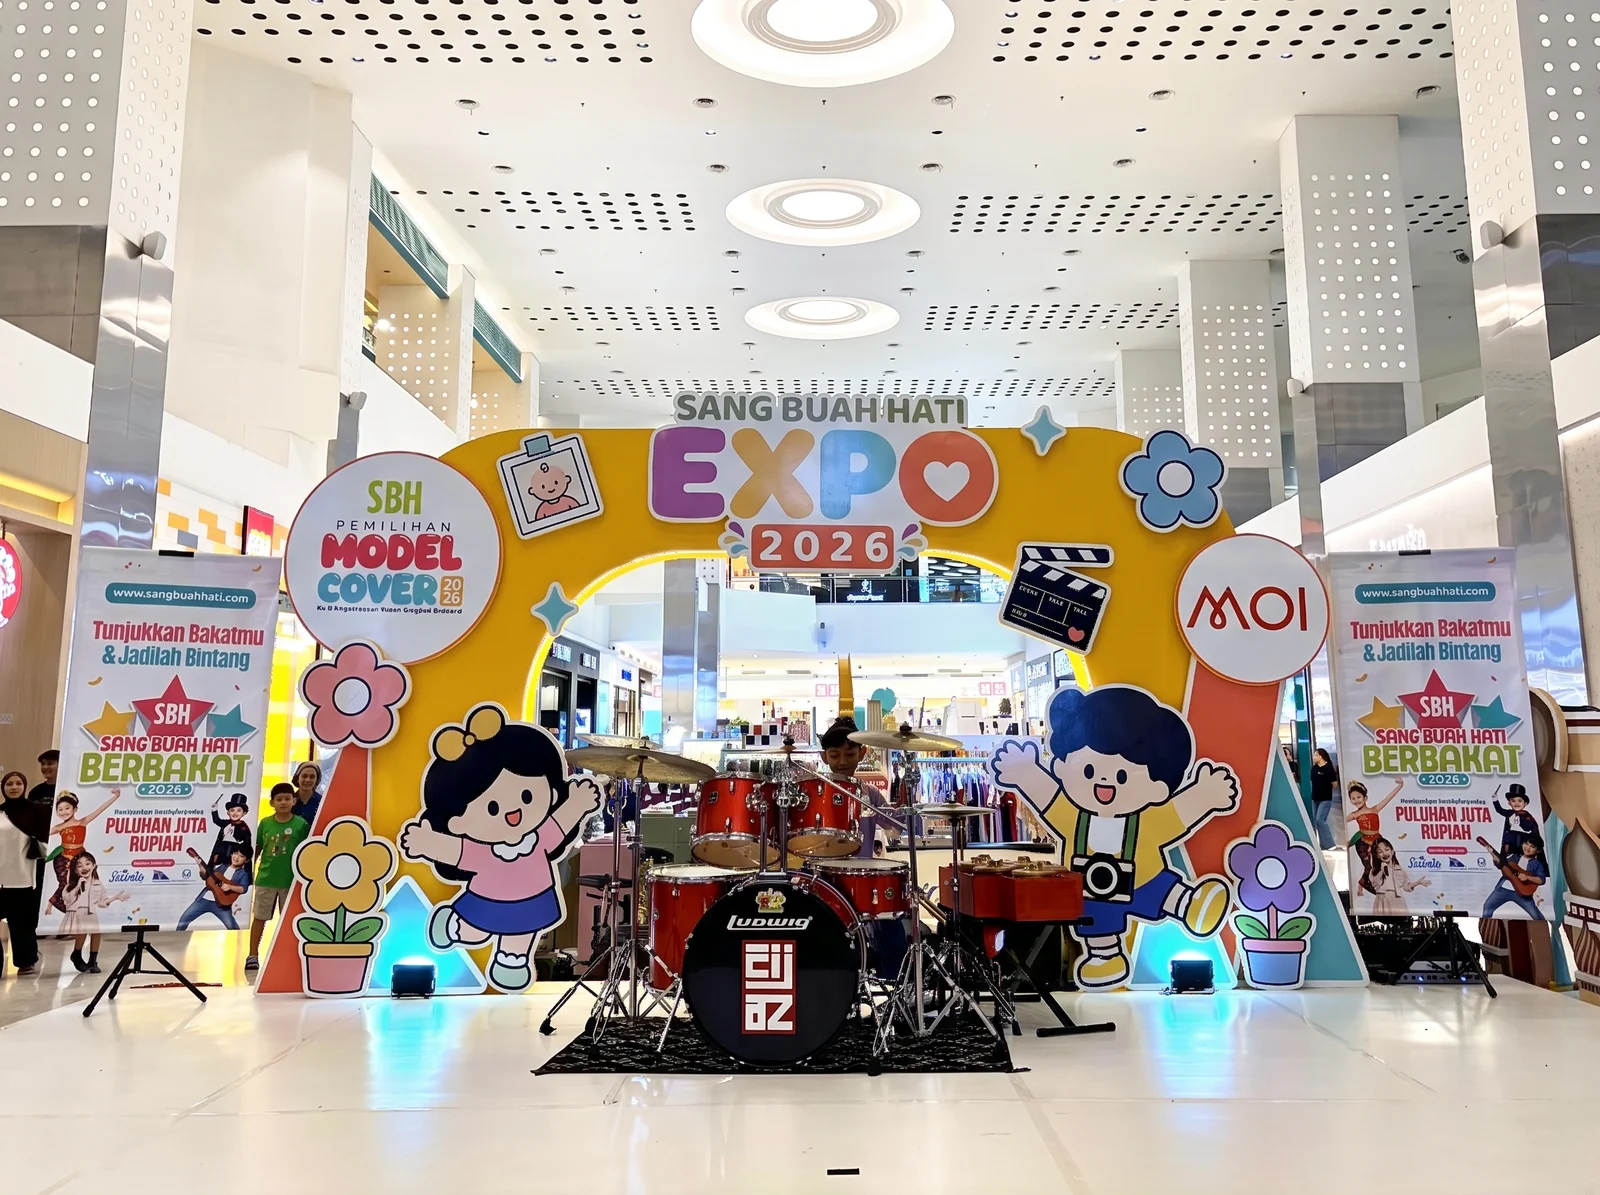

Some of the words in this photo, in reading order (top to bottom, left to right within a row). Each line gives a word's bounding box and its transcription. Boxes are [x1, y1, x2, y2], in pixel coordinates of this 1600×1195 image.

[677, 394, 773, 421] SANG
[782, 396, 877, 423] BUAH
[888, 398, 964, 425] HATI
[652, 426, 995, 523] EXPO
[367, 480, 422, 515] SBH
[336, 520, 451, 532] PEMILIHAN
[321, 533, 463, 571] MODEL
[759, 530, 889, 562] 2026
[113, 588, 249, 603] www.sangbuahhati.com
[317, 572, 438, 606] COVER
[1362, 587, 1488, 599] www.sangbuahhati.com
[1186, 585, 1307, 631] MOI
[93, 620, 185, 643] Tunjukkan
[189, 623, 264, 645] Bakatmu
[1350, 620, 1434, 641] Tunjukkan
[1438, 618, 1511, 638] Bakatmu
[102, 645, 116, 664] &
[118, 645, 182, 666] Jadilah
[185, 648, 250, 671] Bintang
[1363, 644, 1376, 662] &
[1377, 642, 1435, 661] Jadilah
[1439, 641, 1501, 663] Bintang
[154, 702, 191, 725] SBH
[1420, 696, 1454, 717] SBH
[100, 735, 147, 752] SANG
[151, 736, 197, 753] BUAH
[202, 738, 239, 753] HATI
[1375, 729, 1419, 744] SANG
[1423, 728, 1467, 744] BUAH
[1471, 729, 1507, 744] HATI
[79, 752, 251, 783] BERBAKAT
[1363, 745, 1521, 773] BERBAKAT
[148, 785, 182, 794] 2026
[1428, 774, 1459, 784] 2026
[105, 817, 172, 834] PULUHAN
[174, 817, 207, 833] JUTA
[1395, 806, 1457, 822] PULUHAN
[1460, 807, 1492, 823] JUTA
[1421, 824, 1471, 840] RUPIAH
[129, 835, 183, 852] RUPIAH
